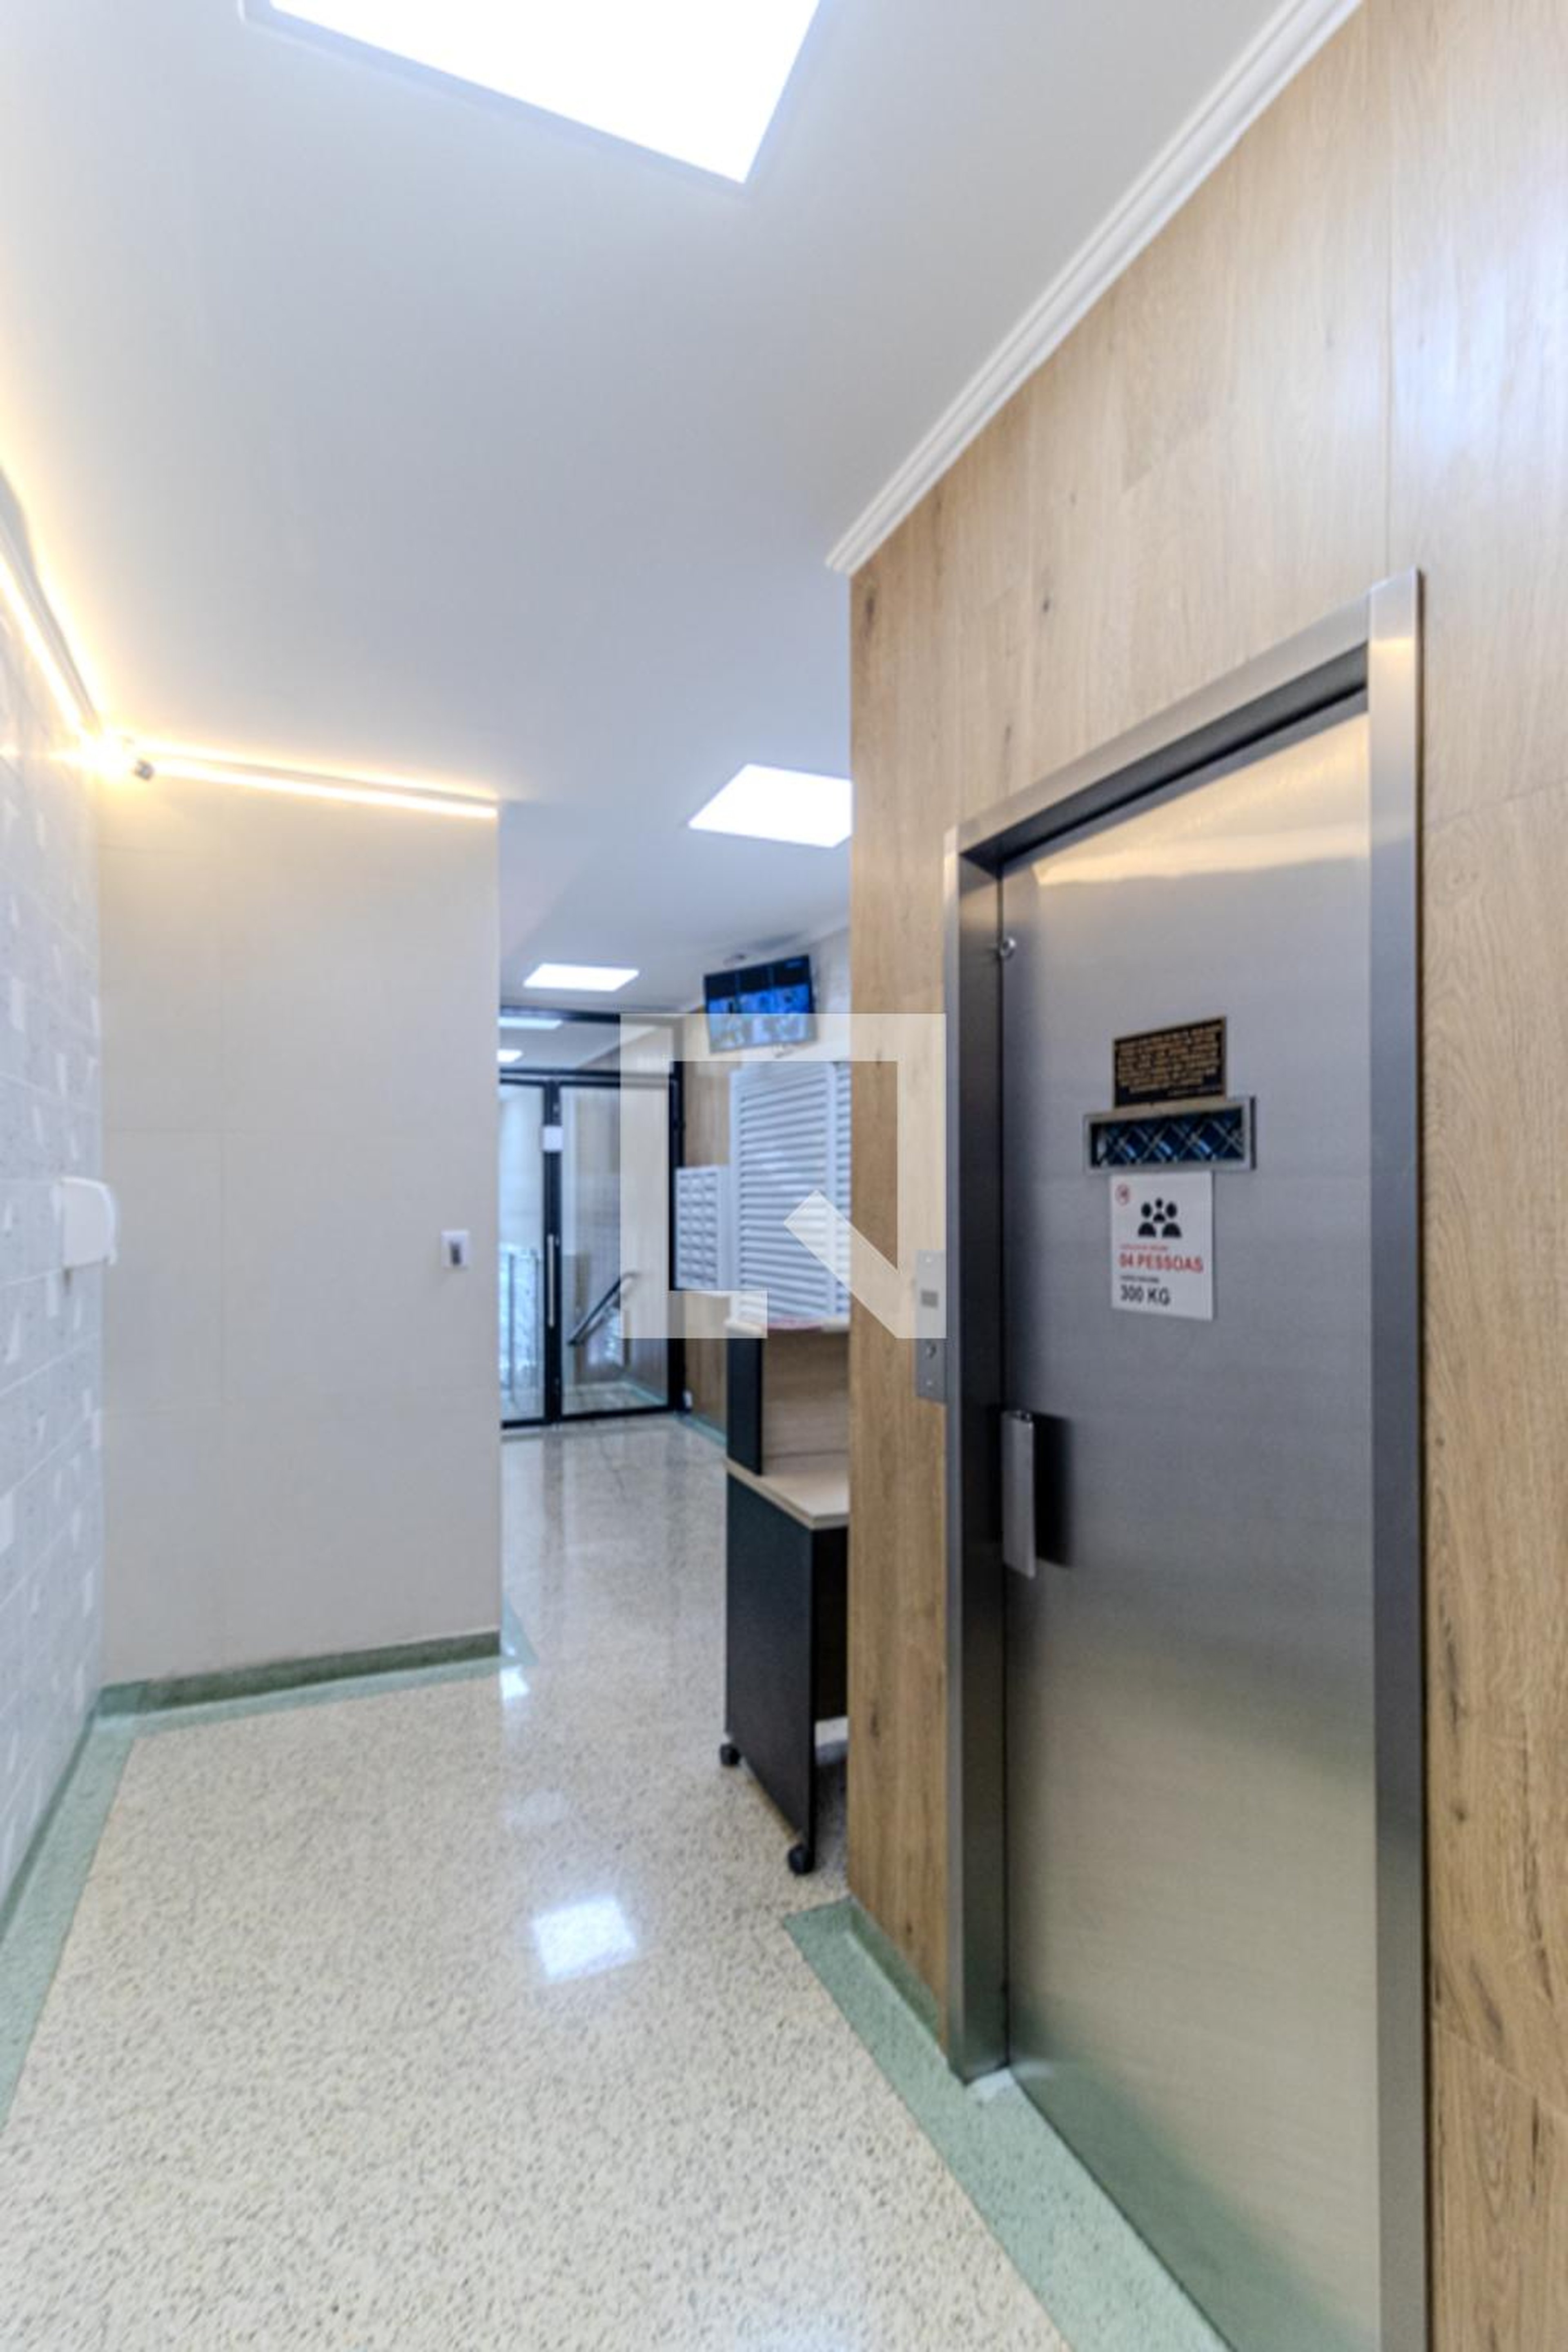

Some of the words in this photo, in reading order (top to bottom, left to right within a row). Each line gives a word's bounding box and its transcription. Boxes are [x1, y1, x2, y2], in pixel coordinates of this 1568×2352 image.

[1137, 1254, 1203, 1273] PESSOAS
[1120, 1284, 1143, 1303] 300
[1147, 1287, 1170, 1306] KG
